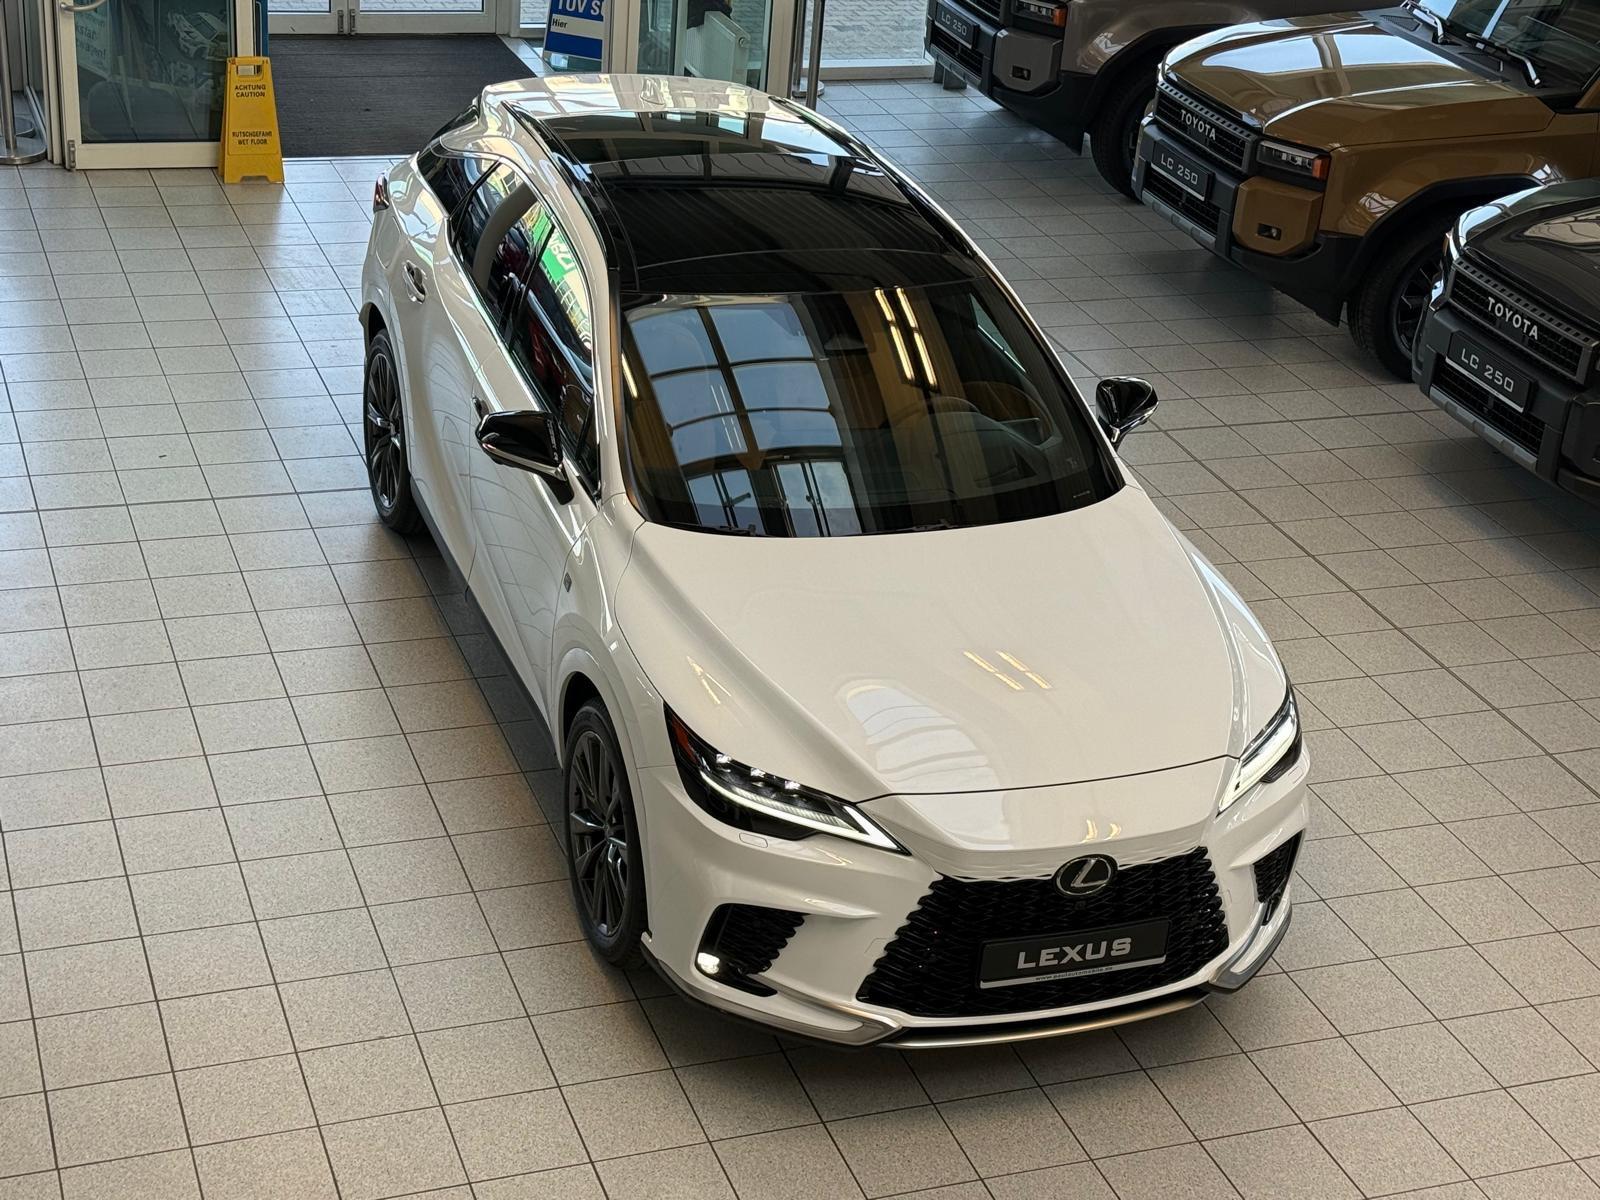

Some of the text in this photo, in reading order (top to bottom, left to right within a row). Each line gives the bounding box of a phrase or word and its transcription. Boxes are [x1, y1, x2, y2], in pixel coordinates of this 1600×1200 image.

[552, 18, 568, 28] Hier
[941, 11, 967, 36] LC 250
[232, 130, 272, 138] RUTSCHGEFAHR
[1180, 109, 1216, 141] TOYOTA
[1161, 153, 1174, 170] LC
[1177, 164, 1198, 185] 250
[1487, 296, 1539, 341] TOYOTA
[1461, 347, 1479, 370] LC
[1484, 365, 1514, 393] 250
[1017, 937, 1132, 970] LEXUS
